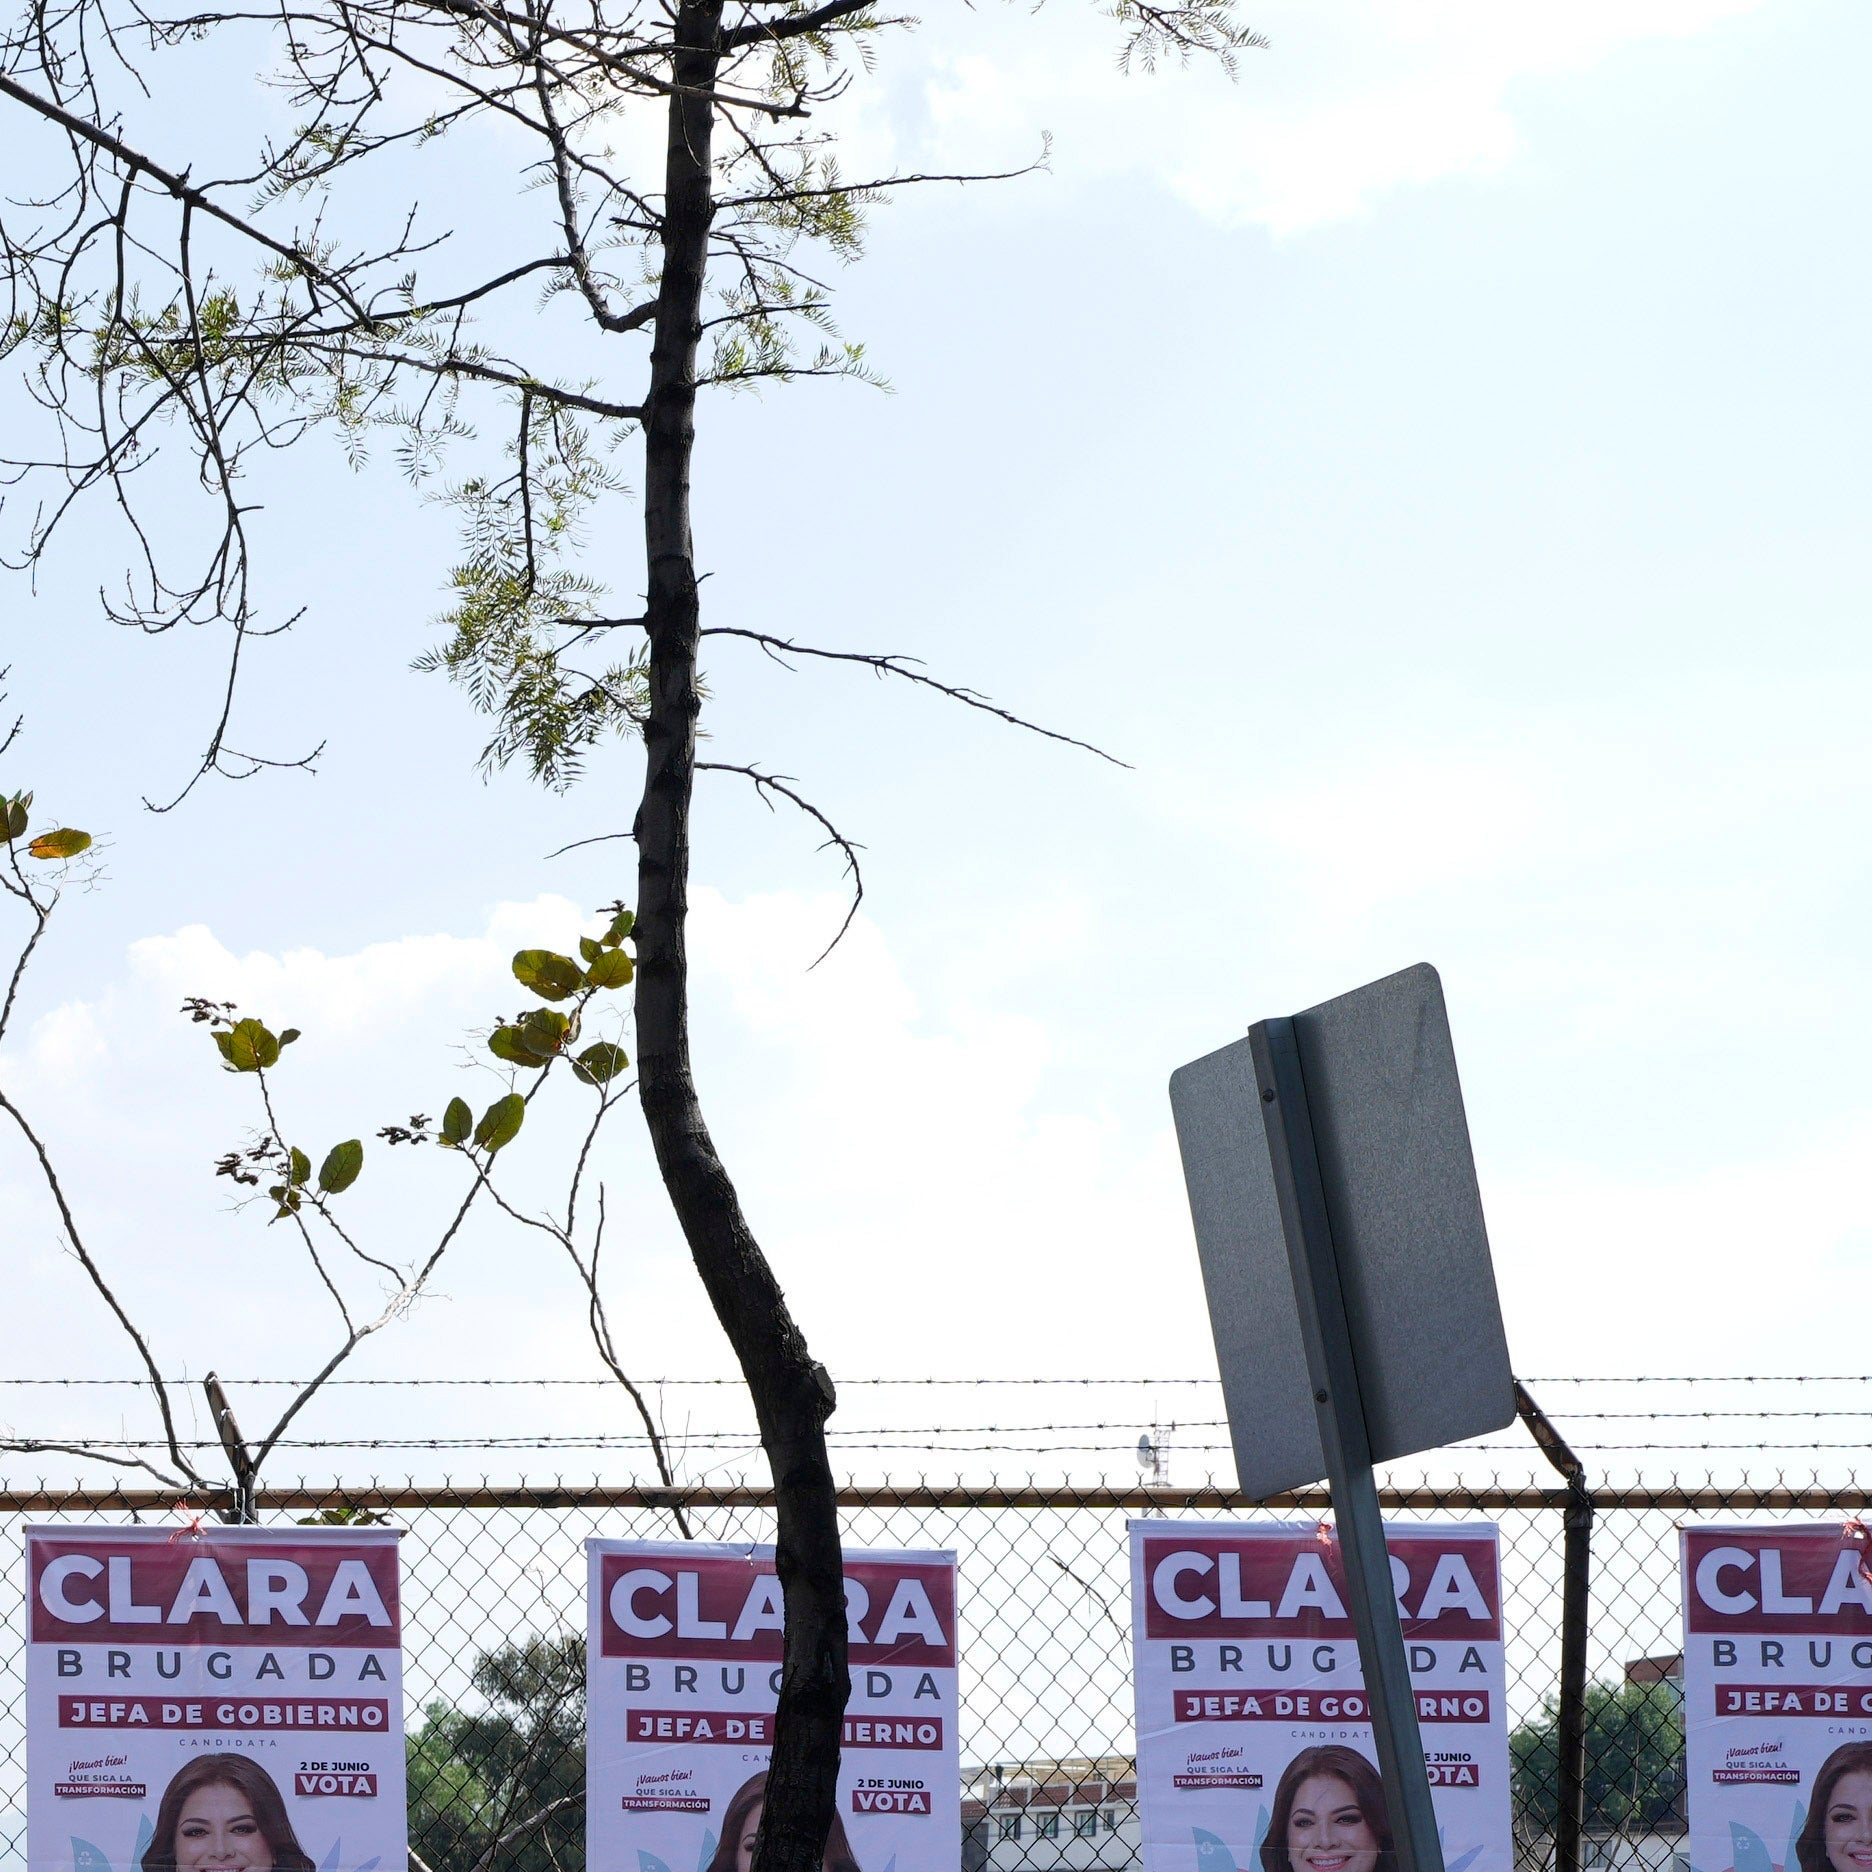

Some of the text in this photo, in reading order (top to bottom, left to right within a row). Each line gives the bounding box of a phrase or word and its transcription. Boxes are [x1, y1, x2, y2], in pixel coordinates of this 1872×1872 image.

[39, 1553, 394, 1628] CLARA
[56, 1649, 388, 1682] BRUGADA
[1185, 1695, 1311, 1717] JEFA DE
[1726, 1690, 1849, 1713] JEFA DE
[70, 1702, 384, 1726] JEFA DE GOBIERNO
[299, 1775, 373, 1795] VOTA
[623, 1798, 709, 1809] TRANSFORMACIÓN
[857, 1792, 927, 1812] VOTA
